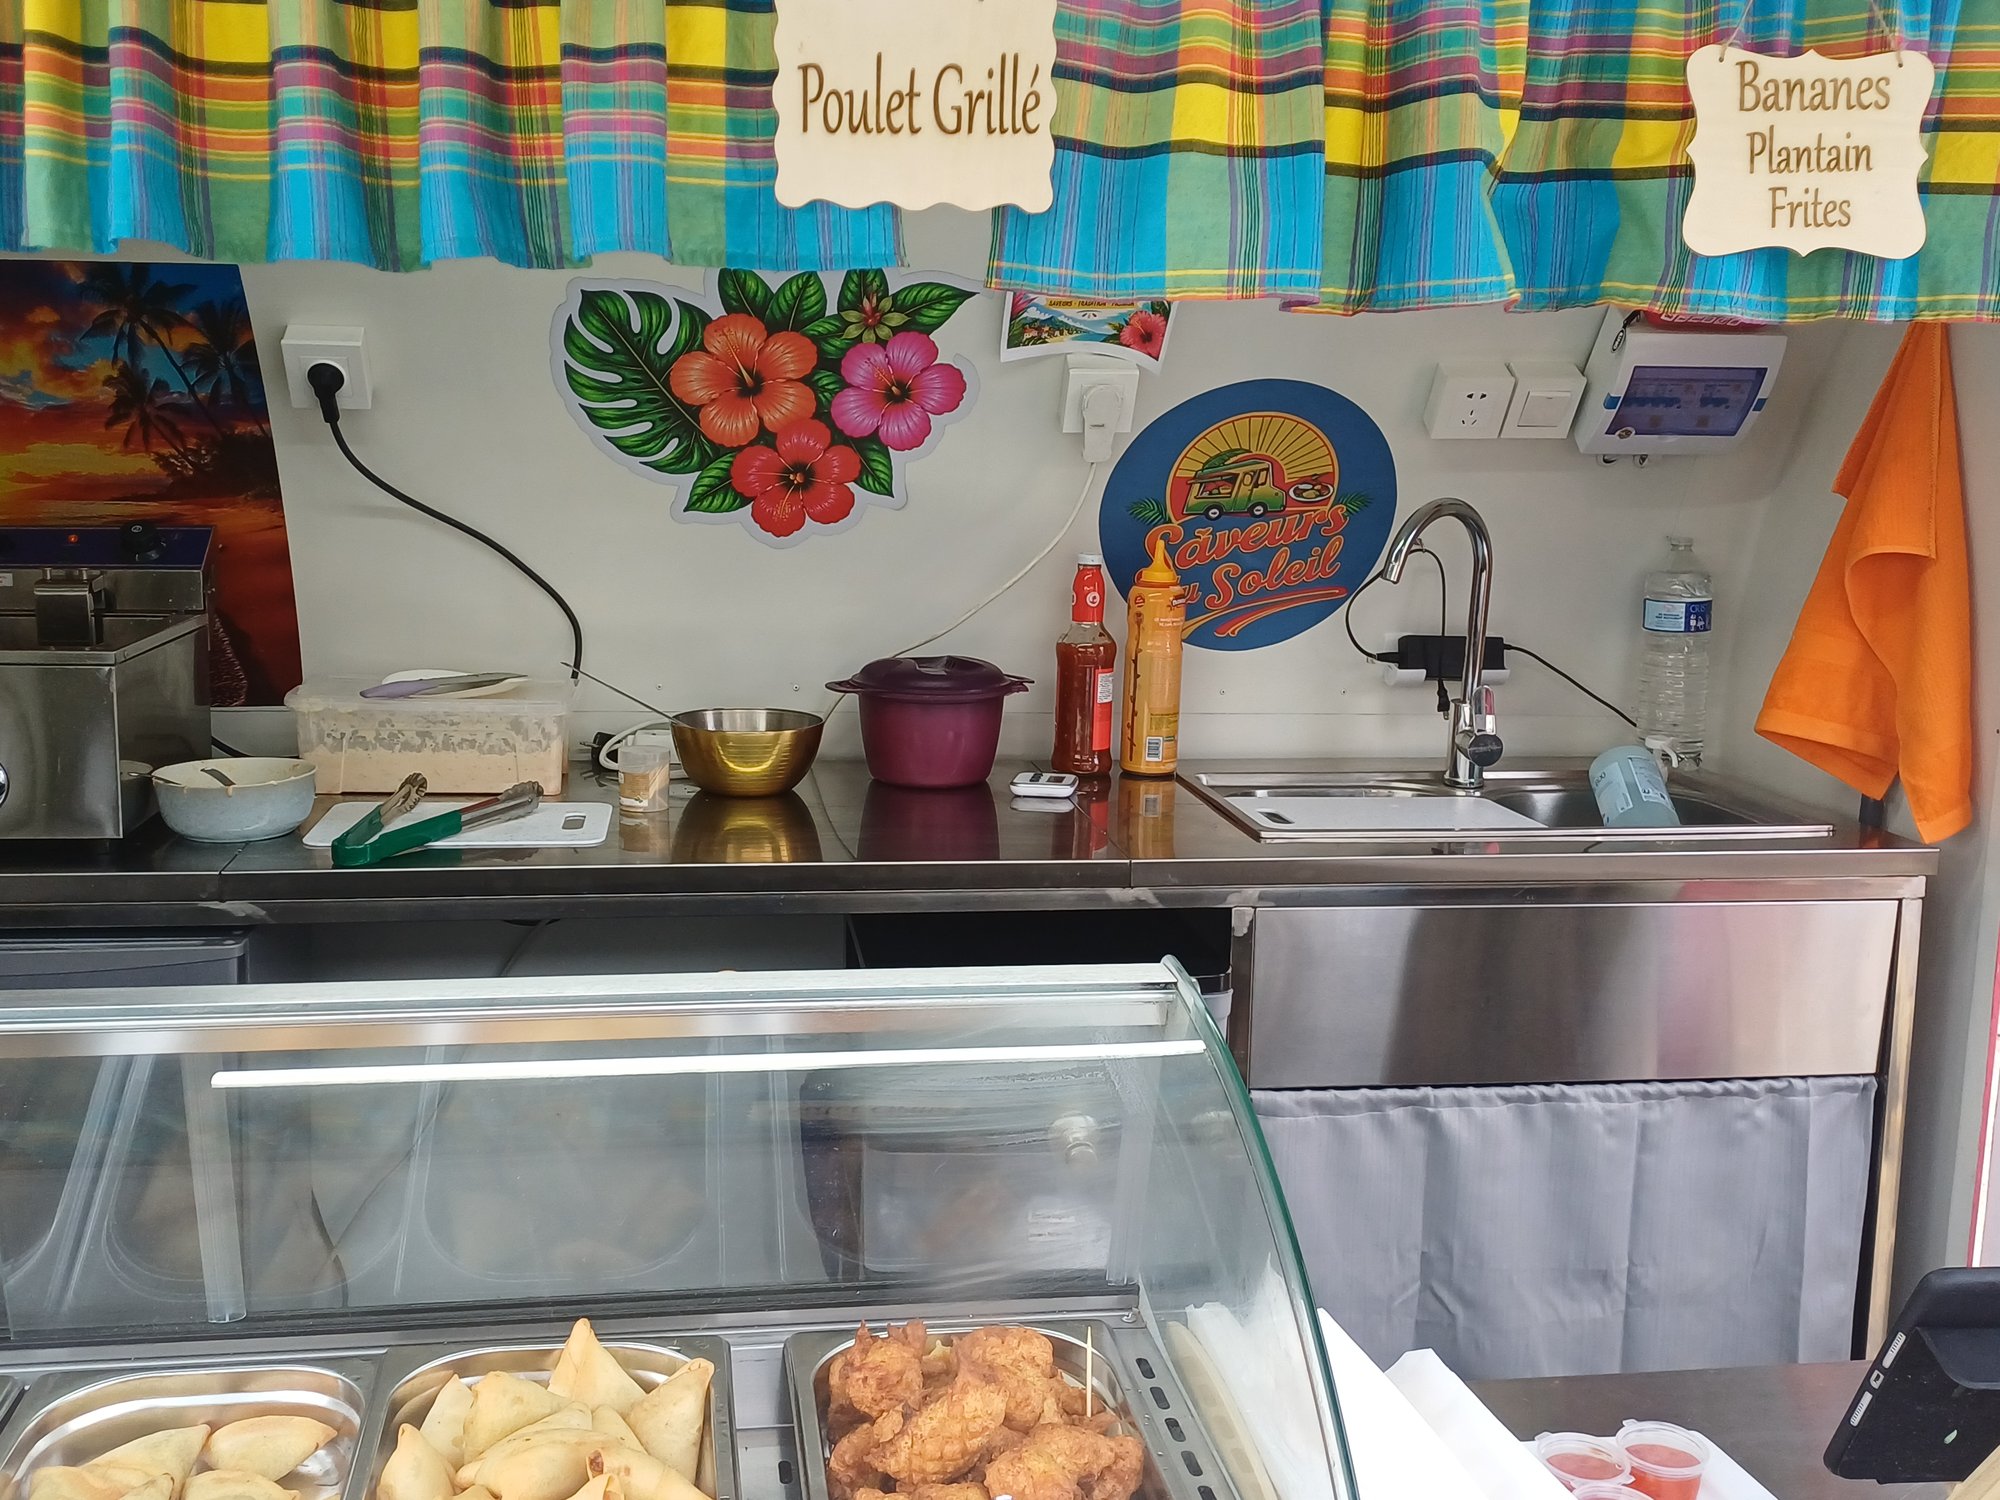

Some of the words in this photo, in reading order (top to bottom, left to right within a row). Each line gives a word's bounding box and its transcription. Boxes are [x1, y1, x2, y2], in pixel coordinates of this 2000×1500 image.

[797, 52, 922, 135] Poulet
[933, 52, 1041, 135] Grillé
[1735, 60, 1891, 112] Bananes
[1746, 124, 1873, 174] Plantain
[1768, 186, 1851, 228] Frites
[1204, 535, 1344, 610] Soleil
